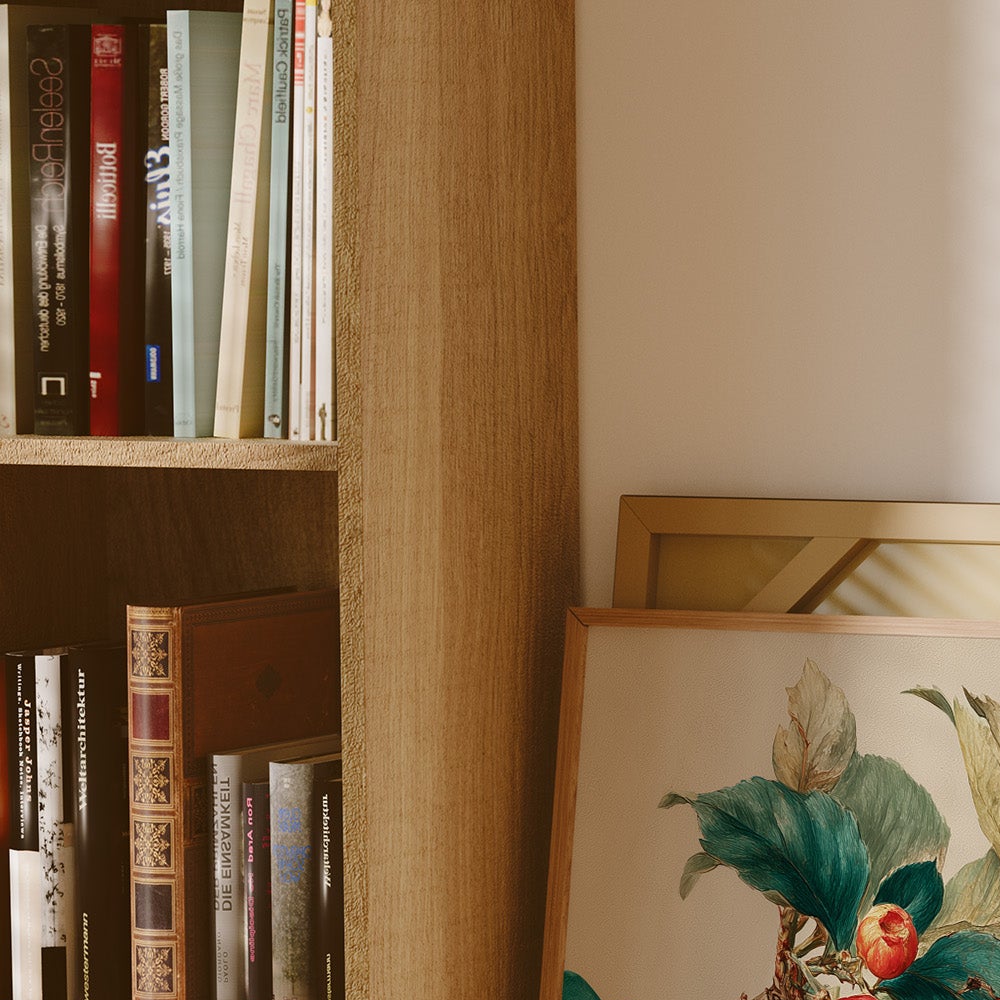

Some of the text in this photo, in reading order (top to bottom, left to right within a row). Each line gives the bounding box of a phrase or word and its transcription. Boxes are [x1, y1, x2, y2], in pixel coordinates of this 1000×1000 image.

[24, 699, 33, 803] Jasper Johns
[77, 669, 87, 811] Weltarchitektur
